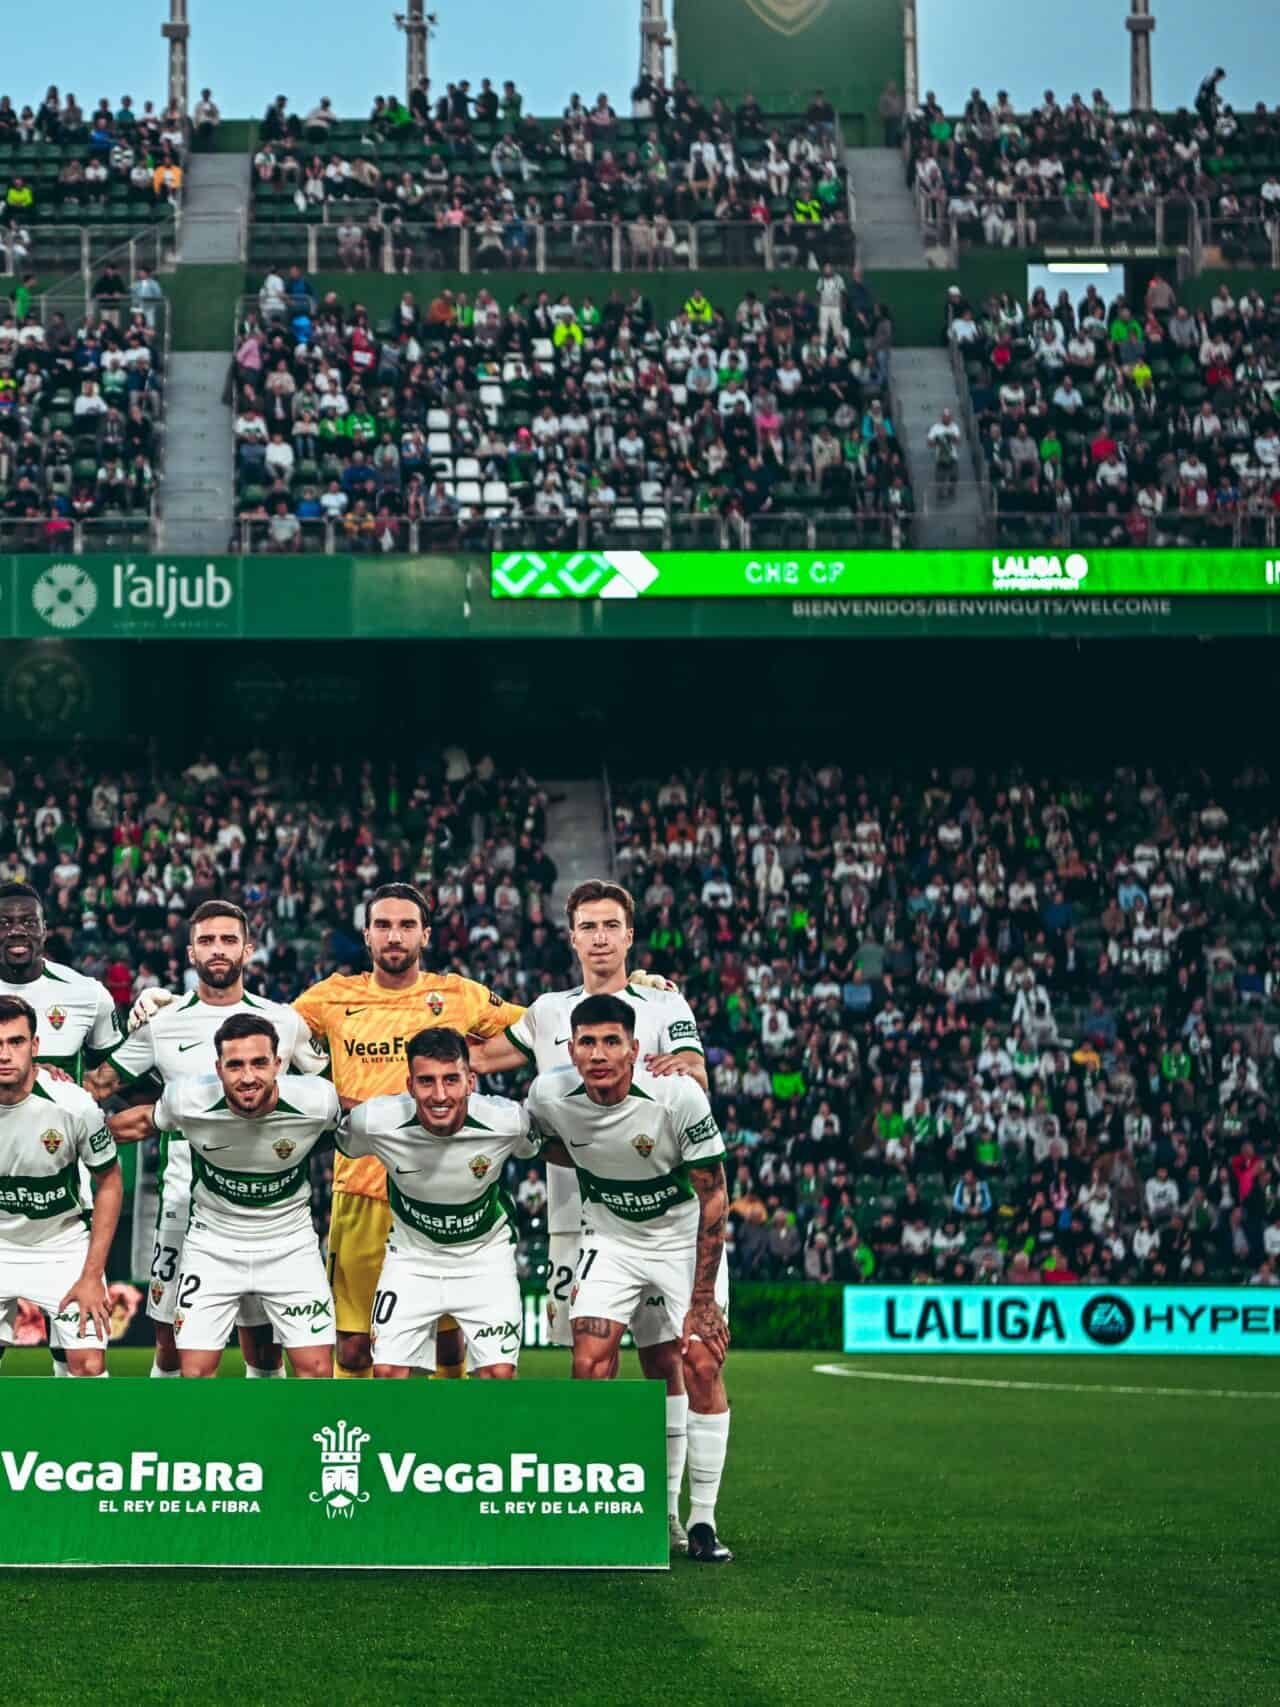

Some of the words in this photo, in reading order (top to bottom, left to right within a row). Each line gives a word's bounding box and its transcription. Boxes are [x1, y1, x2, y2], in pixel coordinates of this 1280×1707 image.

[114, 563, 232, 618] l'aljub
[151, 1242, 178, 1282] 23
[176, 1273, 201, 1308] 12
[371, 1290, 398, 1325] 10
[885, 1299, 1066, 1341] LALIGA
[99, 1500, 118, 1513] EL
[124, 1500, 155, 1513] REY
[160, 1500, 181, 1513] DE
[186, 1500, 207, 1513] LA
[212, 1500, 261, 1513] FIBRA
[480, 1501, 499, 1514] EL
[505, 1501, 536, 1515] REY
[542, 1501, 563, 1514] DE
[568, 1501, 589, 1515] LA
[595, 1501, 644, 1515] FIBRA
